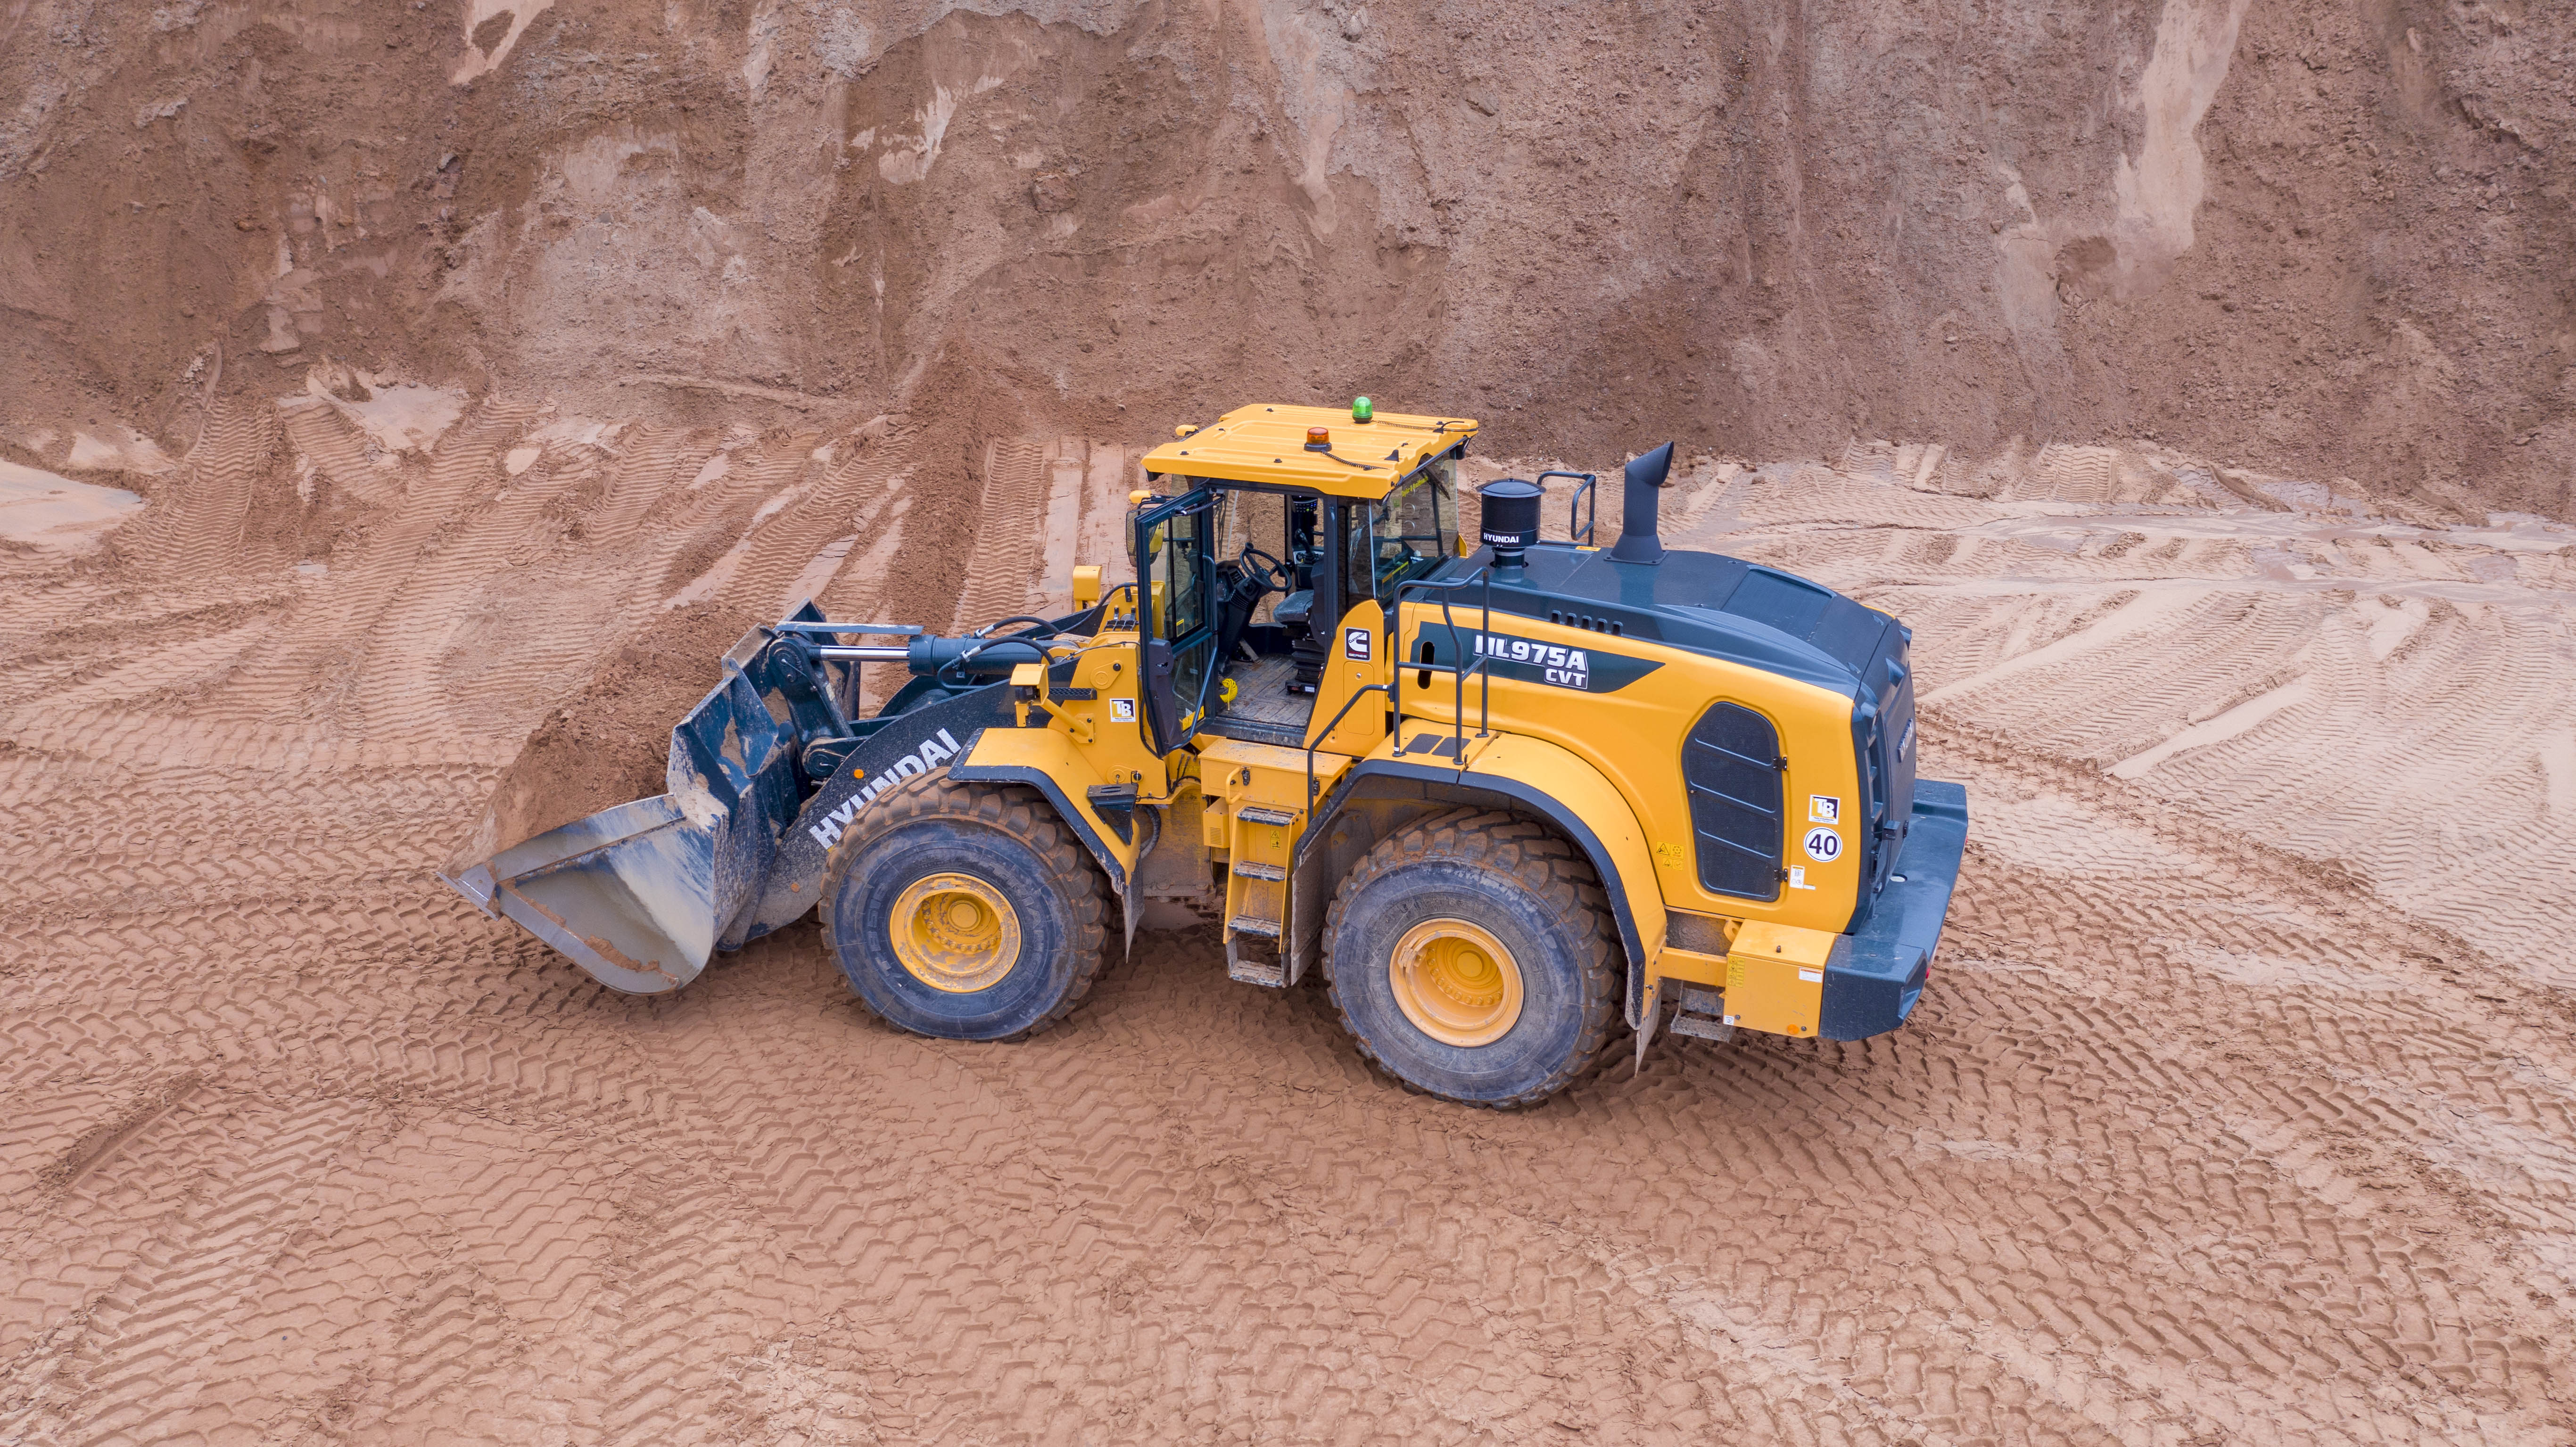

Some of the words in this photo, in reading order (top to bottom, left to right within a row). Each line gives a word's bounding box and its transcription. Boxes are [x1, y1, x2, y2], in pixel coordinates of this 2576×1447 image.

[1484, 532, 1519, 543] HYUNDAI
[1349, 633, 1365, 643] Cummins
[1545, 668, 1586, 686] CVT
[1114, 701, 1131, 716] TB
[809, 728, 961, 850] HYUNDAI
[1815, 797, 1835, 818] TB
[1808, 834, 1838, 855] 40
